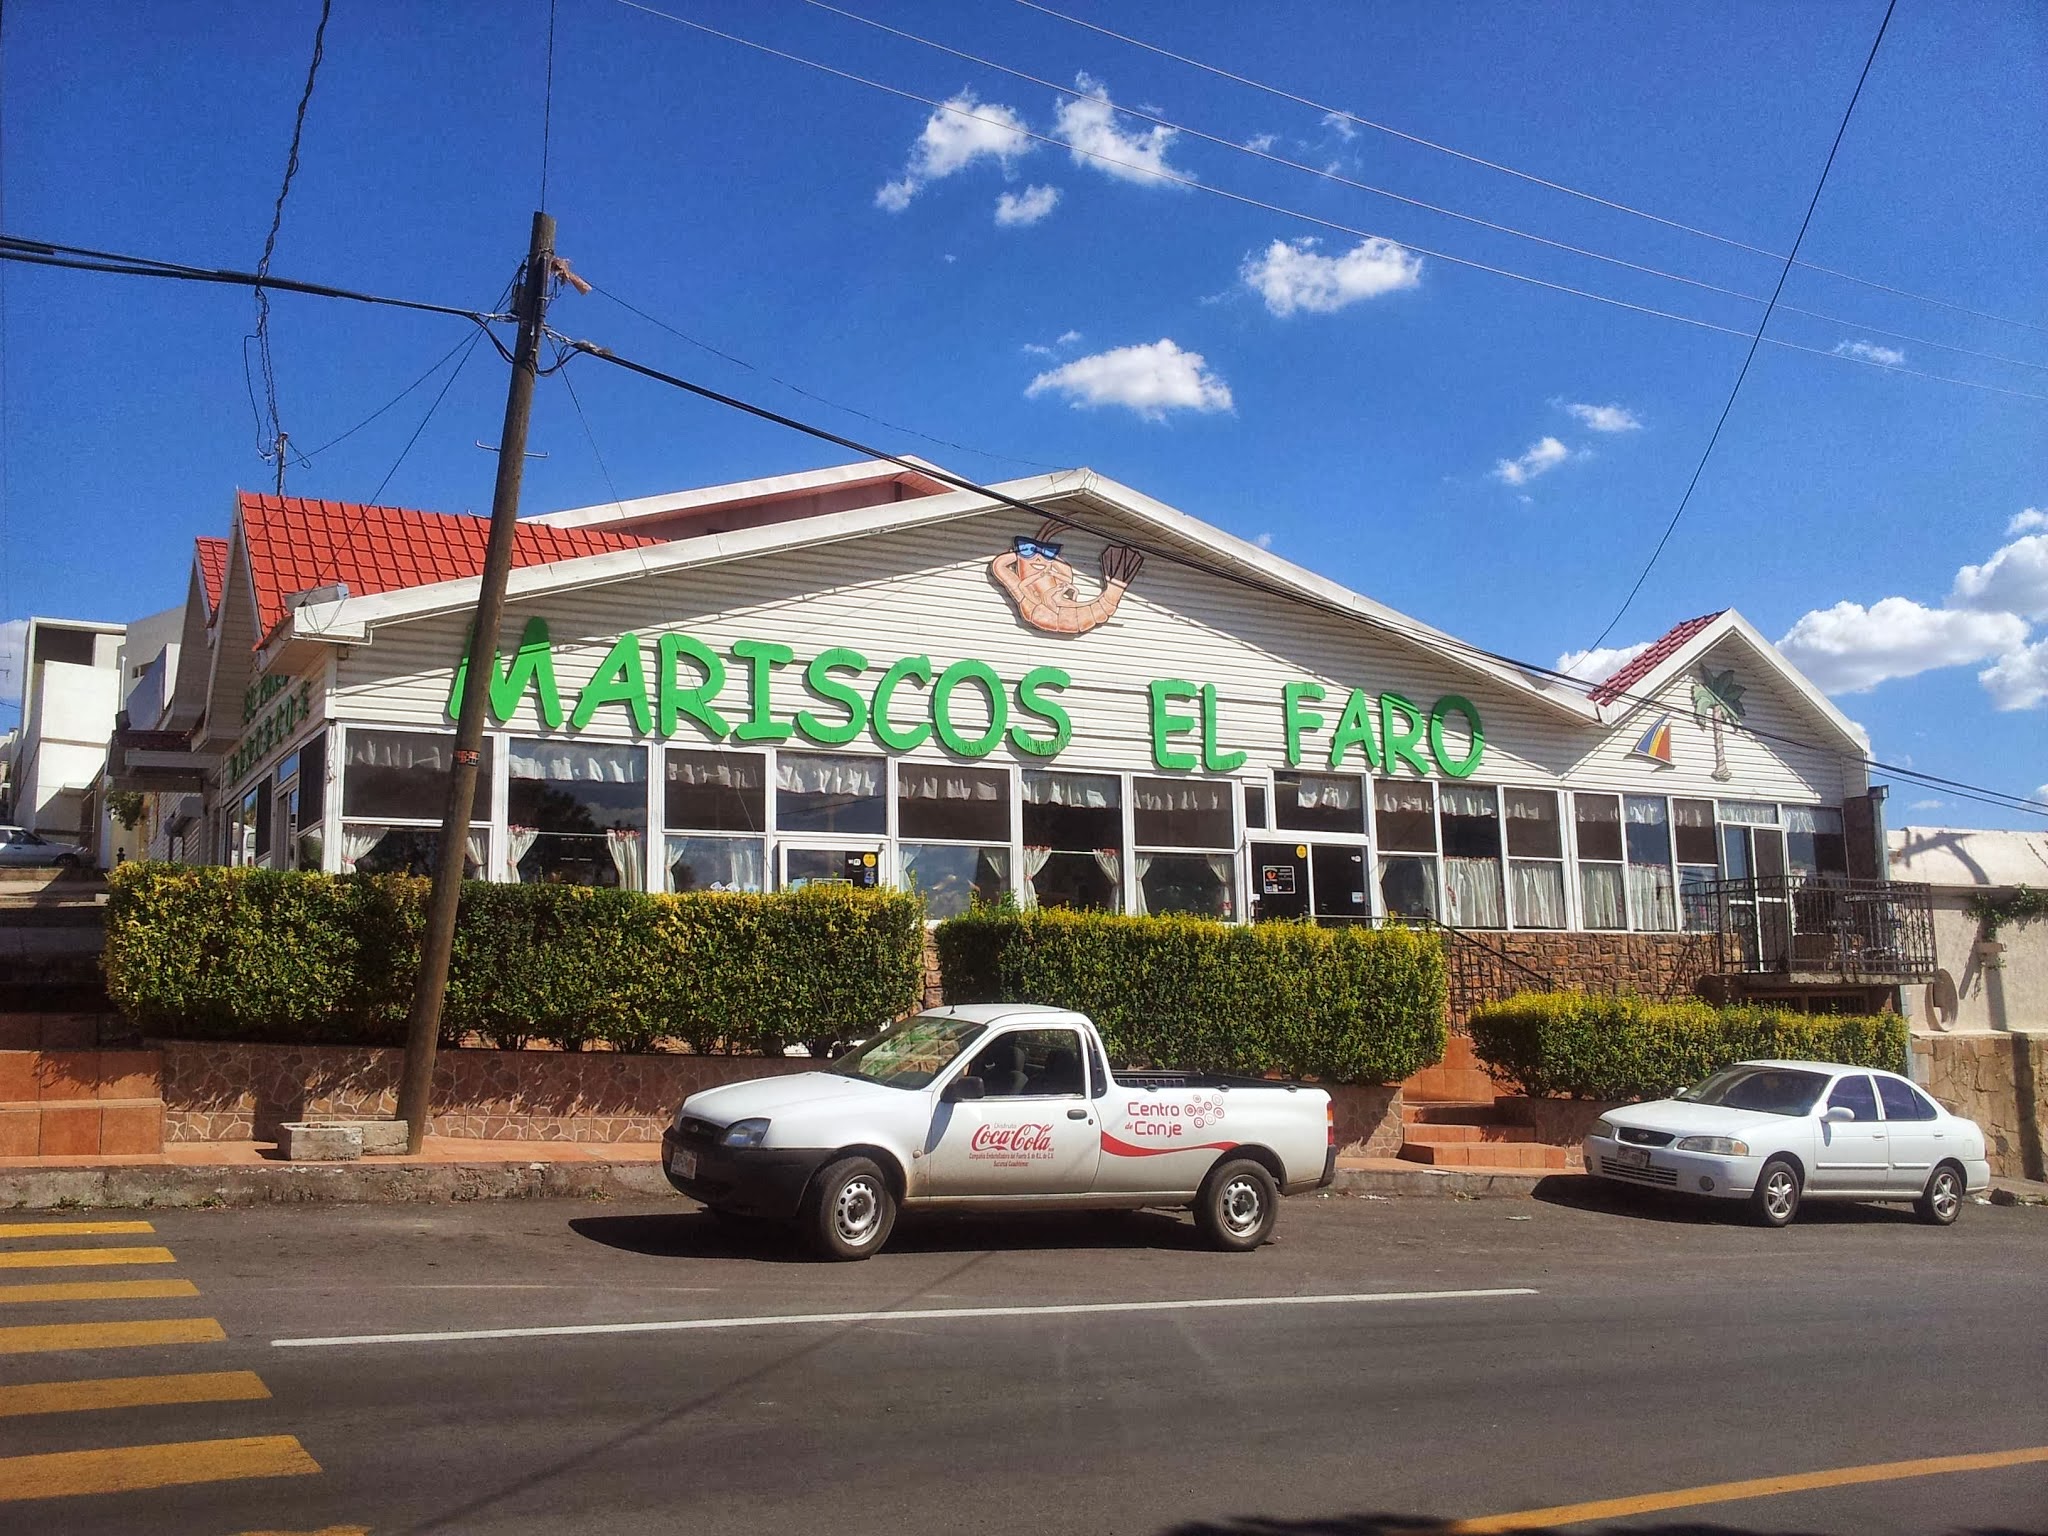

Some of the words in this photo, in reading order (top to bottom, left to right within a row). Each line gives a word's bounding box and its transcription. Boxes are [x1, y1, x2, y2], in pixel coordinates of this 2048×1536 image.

[449, 616, 1072, 757] MARISCOS
[1150, 680, 1248, 773] EL
[1286, 682, 1485, 779] FARO
[1127, 1101, 1180, 1117] Centro
[971, 1123, 1054, 1151] Coca-Cola
[1124, 1121, 1133, 1130] de
[1134, 1120, 1183, 1138] Canje
